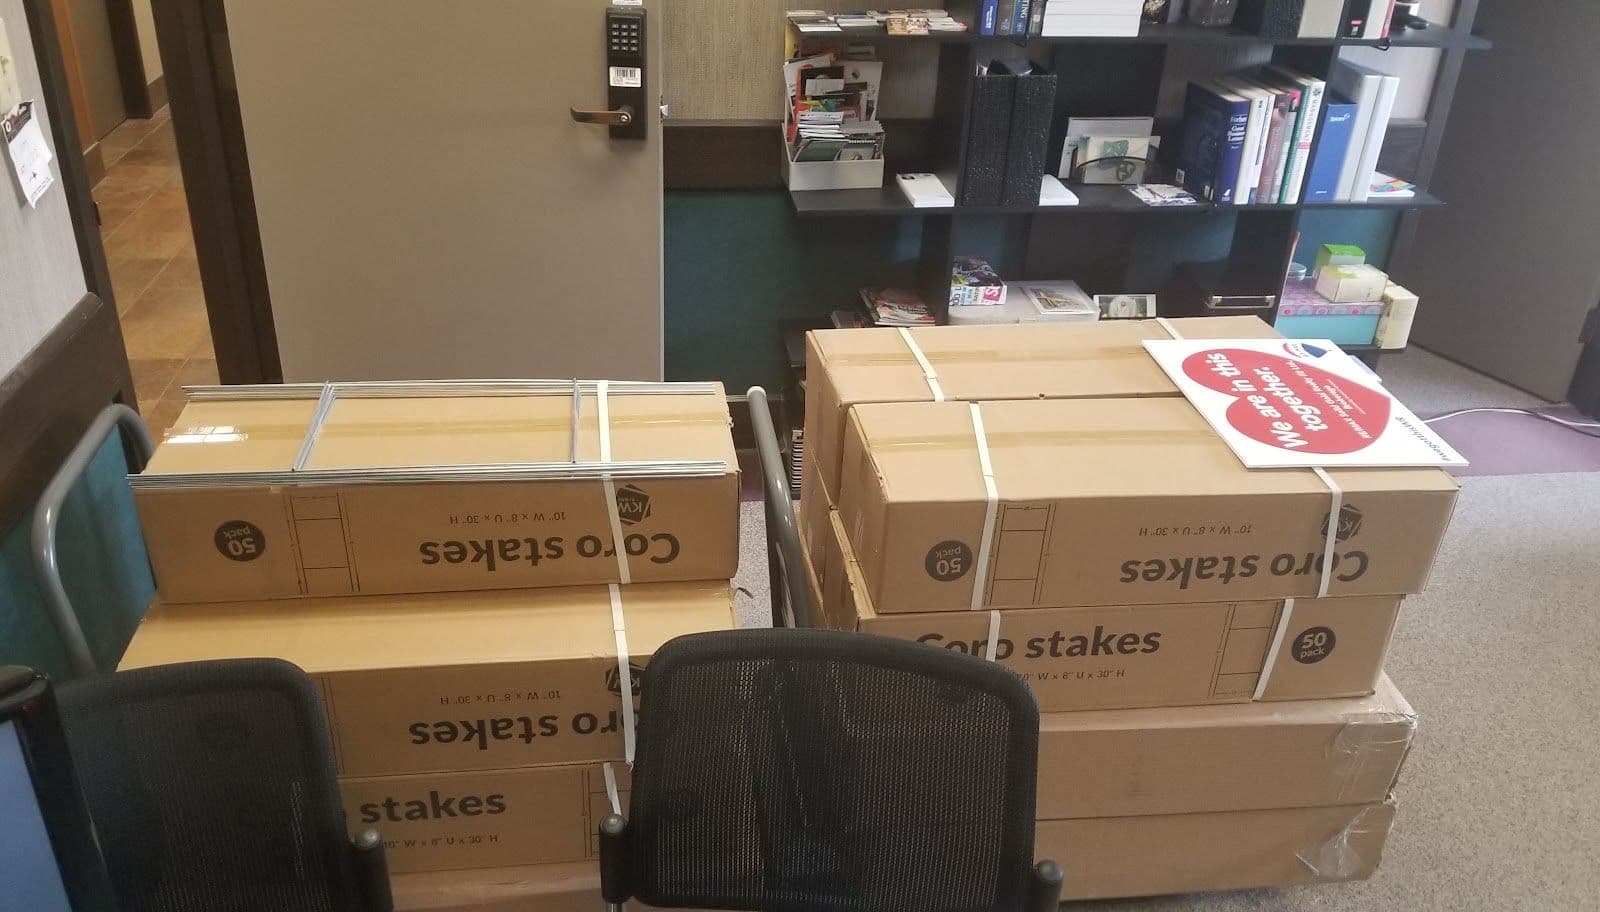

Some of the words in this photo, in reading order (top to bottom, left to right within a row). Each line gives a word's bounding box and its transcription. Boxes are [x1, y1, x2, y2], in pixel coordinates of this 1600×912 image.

[1205, 353, 1242, 377] this
[1231, 380, 1258, 392] in
[1253, 366, 1328, 432] together.
[1246, 395, 1282, 418] are
[1270, 421, 1309, 448] We
[1343, 418, 1372, 439] RE/MAX
[450, 516, 458, 524] H
[462, 515, 480, 524] 30"
[494, 514, 503, 523] U
[506, 513, 518, 522] 8"
[534, 512, 545, 521] W
[550, 510, 566, 521] 10"
[224, 526, 250, 539] pack
[1139, 528, 1148, 536] H
[1150, 527, 1168, 536] 30"
[1182, 527, 1191, 536] U
[1193, 526, 1205, 536] 8"
[1220, 526, 1232, 535] W
[228, 538, 256, 556] 50
[936, 546, 960, 559] pack
[420, 536, 564, 572] stakes
[936, 557, 961, 575] 50
[1120, 554, 1260, 590] stakes
[1270, 550, 1369, 582] Coro
[1024, 626, 1162, 659] stakes
[1302, 632, 1328, 649] 50
[1300, 648, 1326, 659] pack
[1038, 672, 1049, 681] W
[1076, 671, 1084, 679] U
[1116, 669, 1125, 677] H
[440, 696, 449, 705] H
[487, 694, 495, 702] U
[527, 692, 539, 700] W
[408, 715, 558, 750] stakes
[360, 790, 506, 824] stakes
[404, 840, 416, 848] W
[489, 834, 498, 842] H
